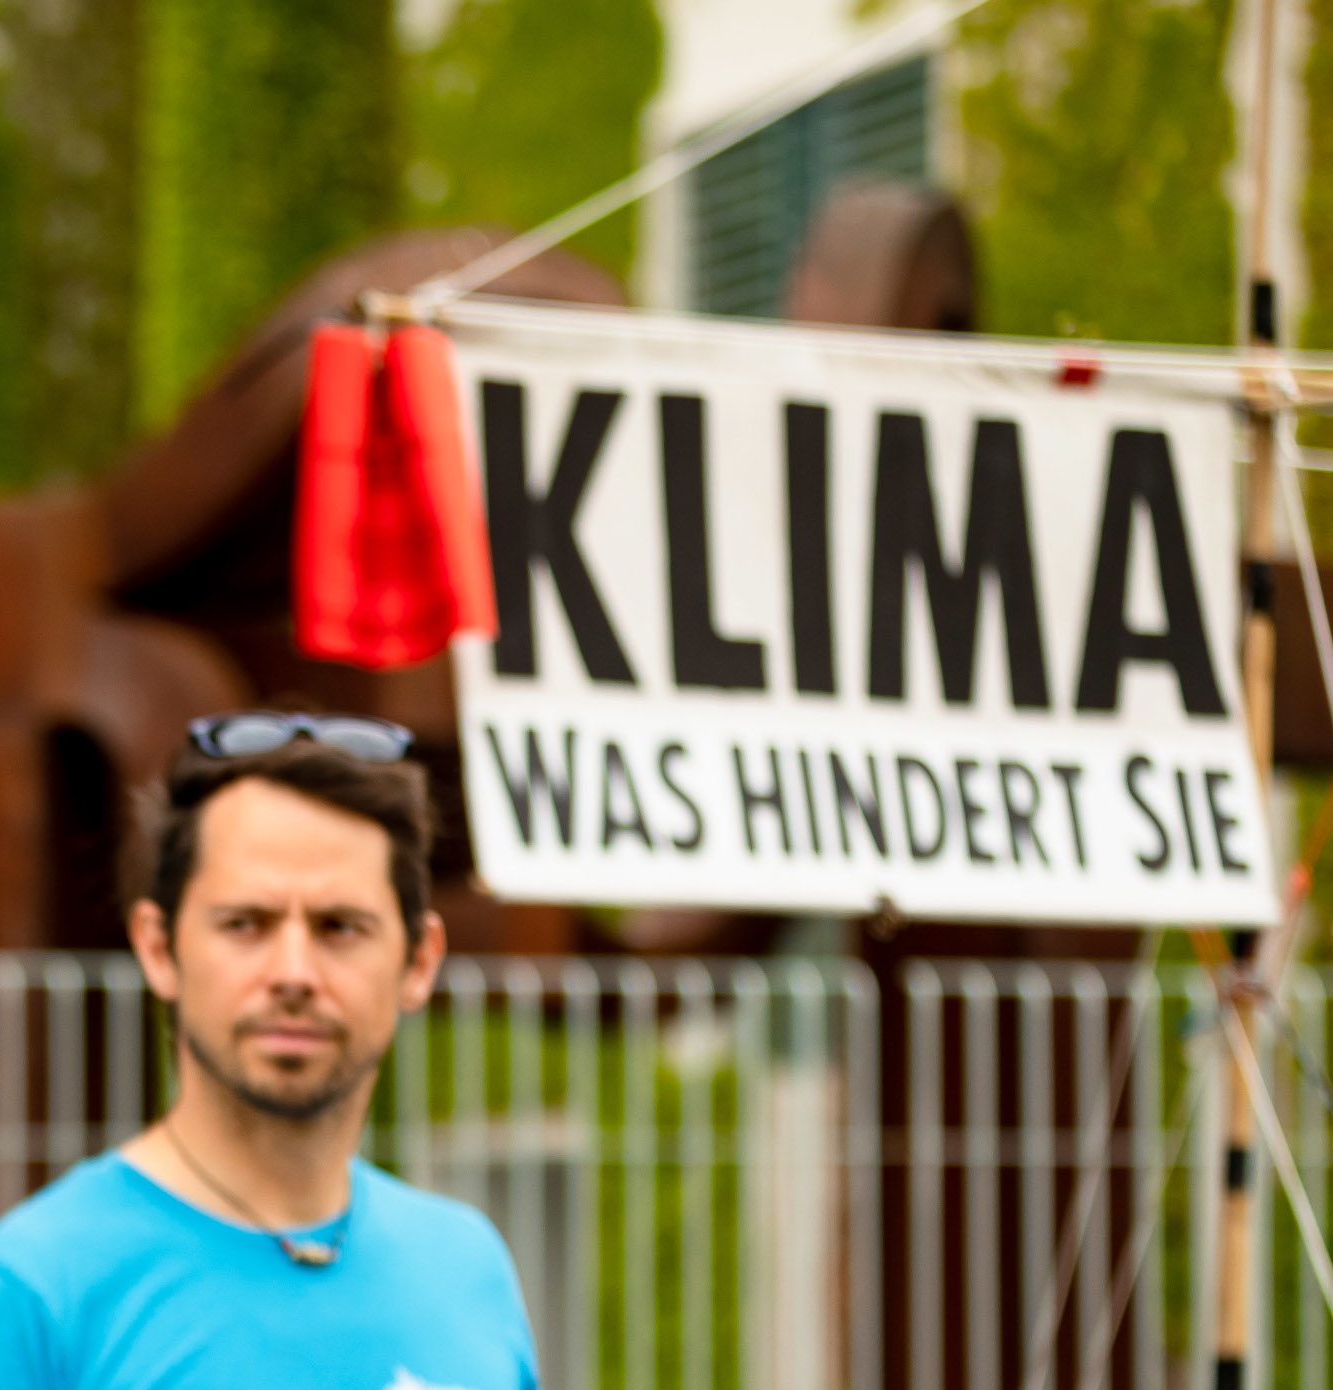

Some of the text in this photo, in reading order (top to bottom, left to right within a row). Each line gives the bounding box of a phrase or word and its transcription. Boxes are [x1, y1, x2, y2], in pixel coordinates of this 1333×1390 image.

[479, 378, 1231, 720] KLIMA
[483, 725, 1250, 874] WAS HINDERT SIE
